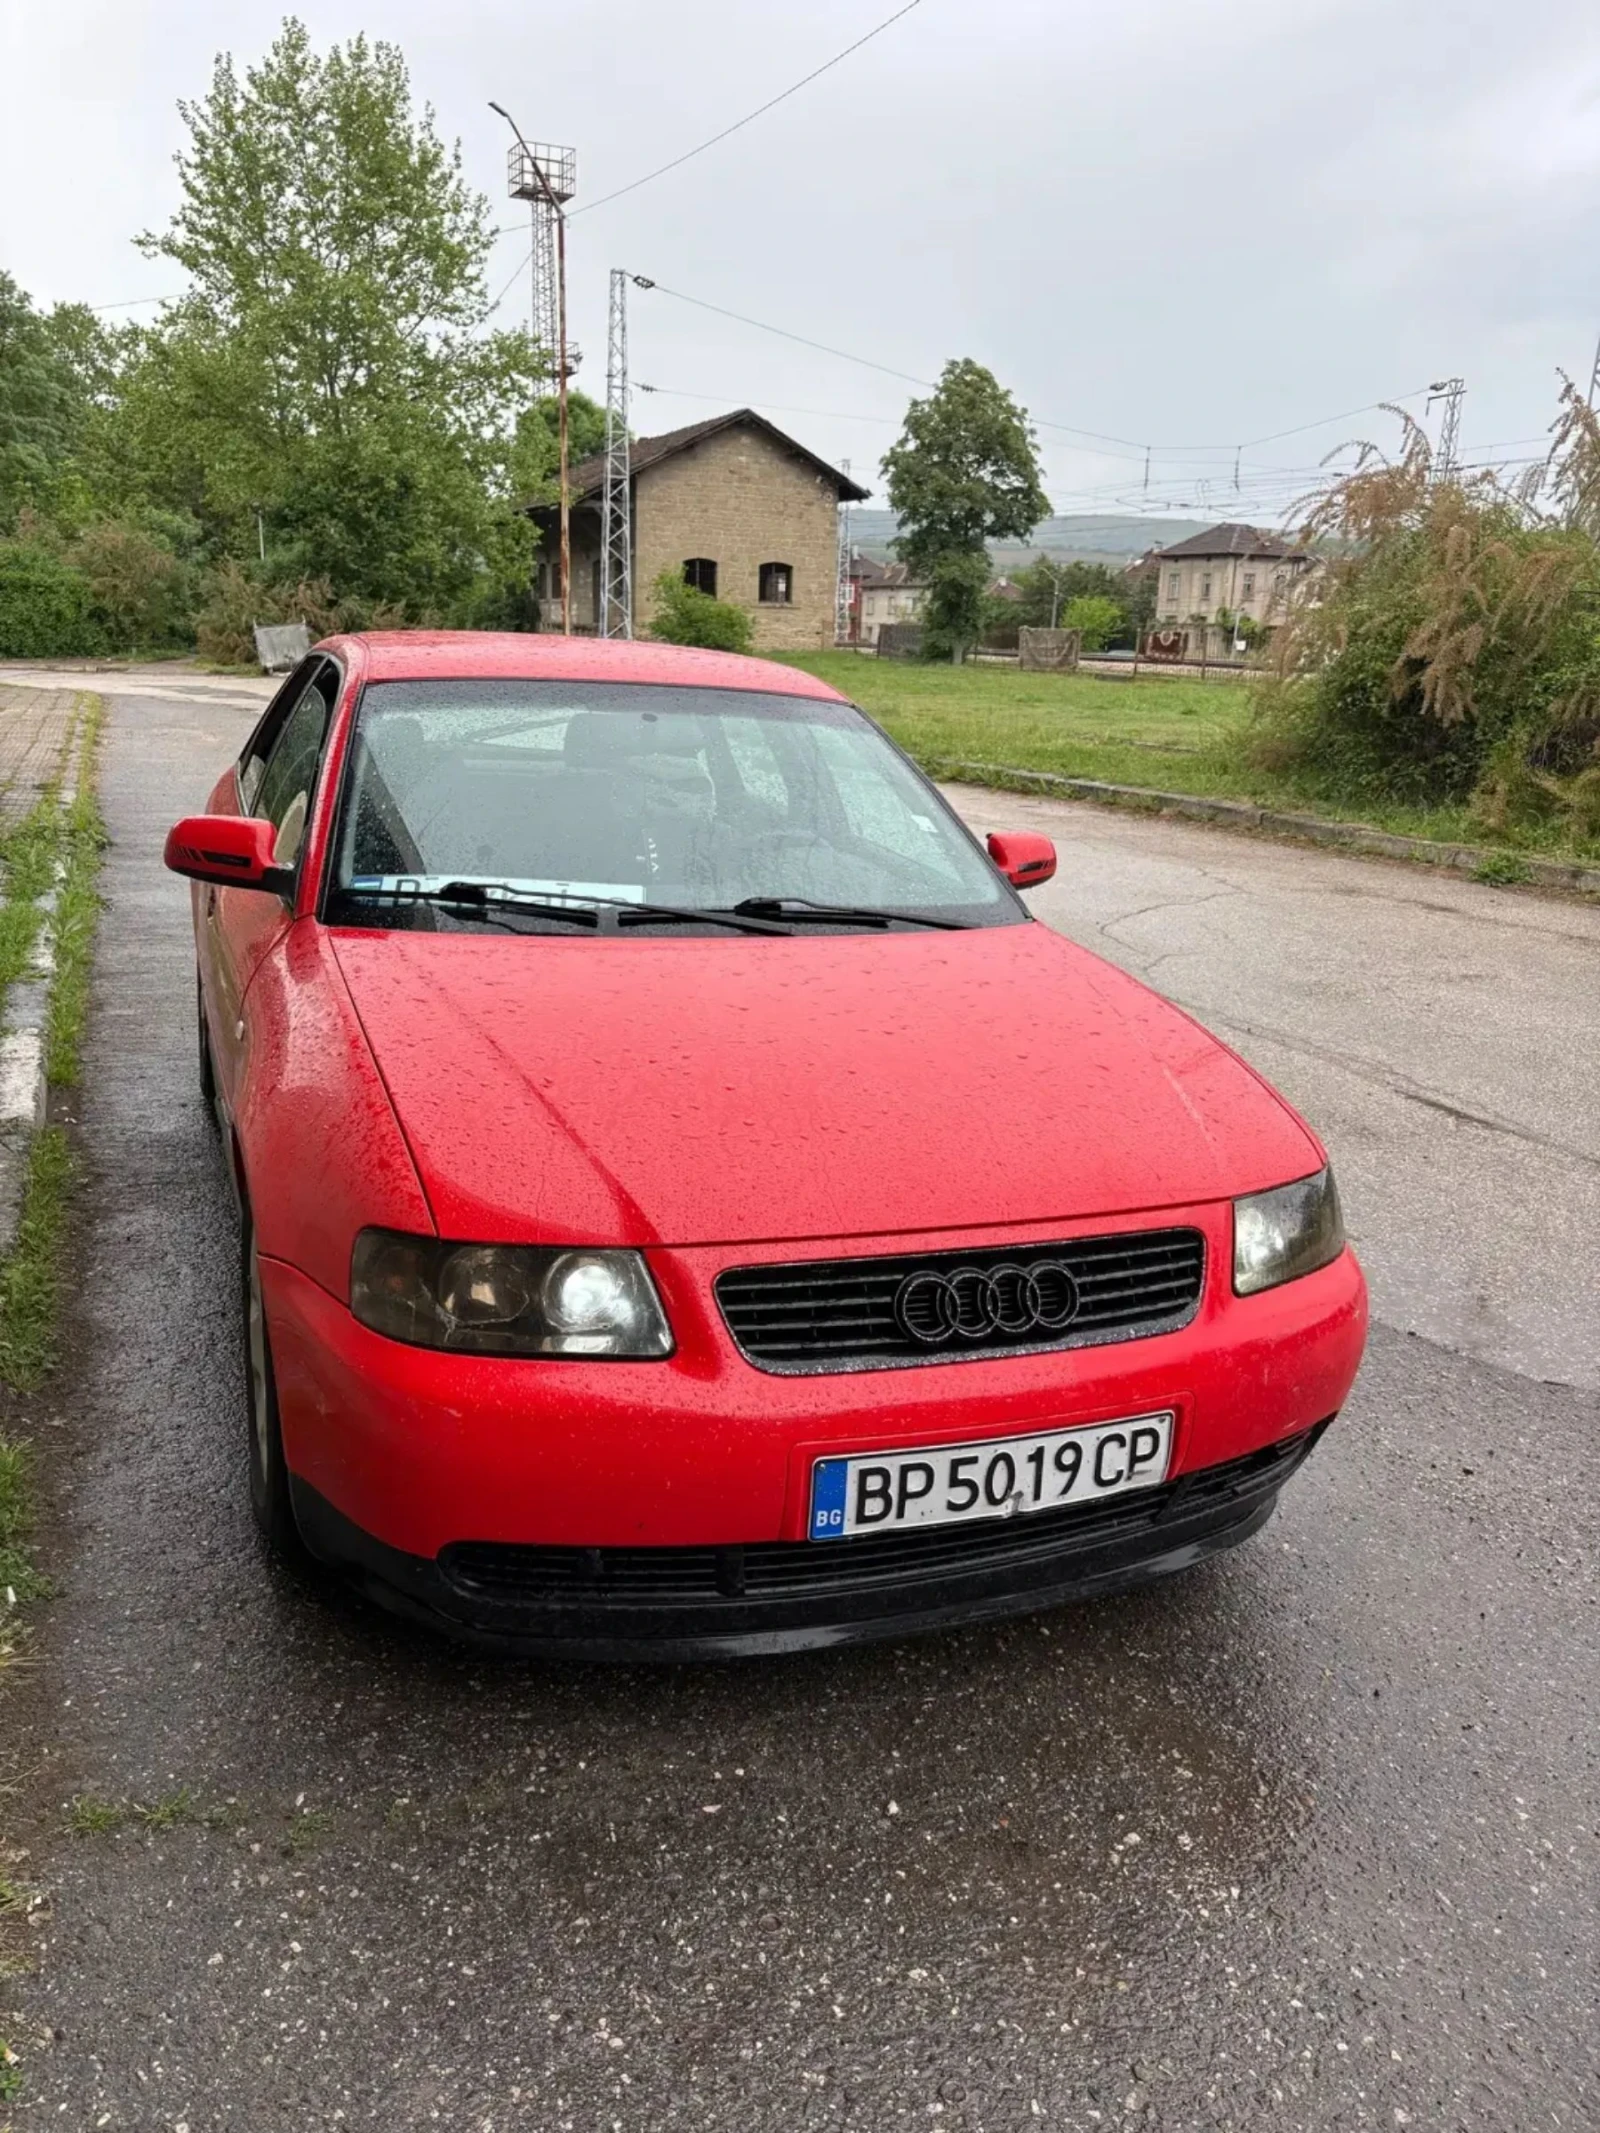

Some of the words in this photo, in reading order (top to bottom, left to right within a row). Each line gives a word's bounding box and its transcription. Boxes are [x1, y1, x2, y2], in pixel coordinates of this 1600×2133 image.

[854, 1463, 935, 1525] BP
[946, 1441, 1083, 1512] 5019
[1092, 1427, 1161, 1488] CP
[816, 1510, 841, 1527] BG
